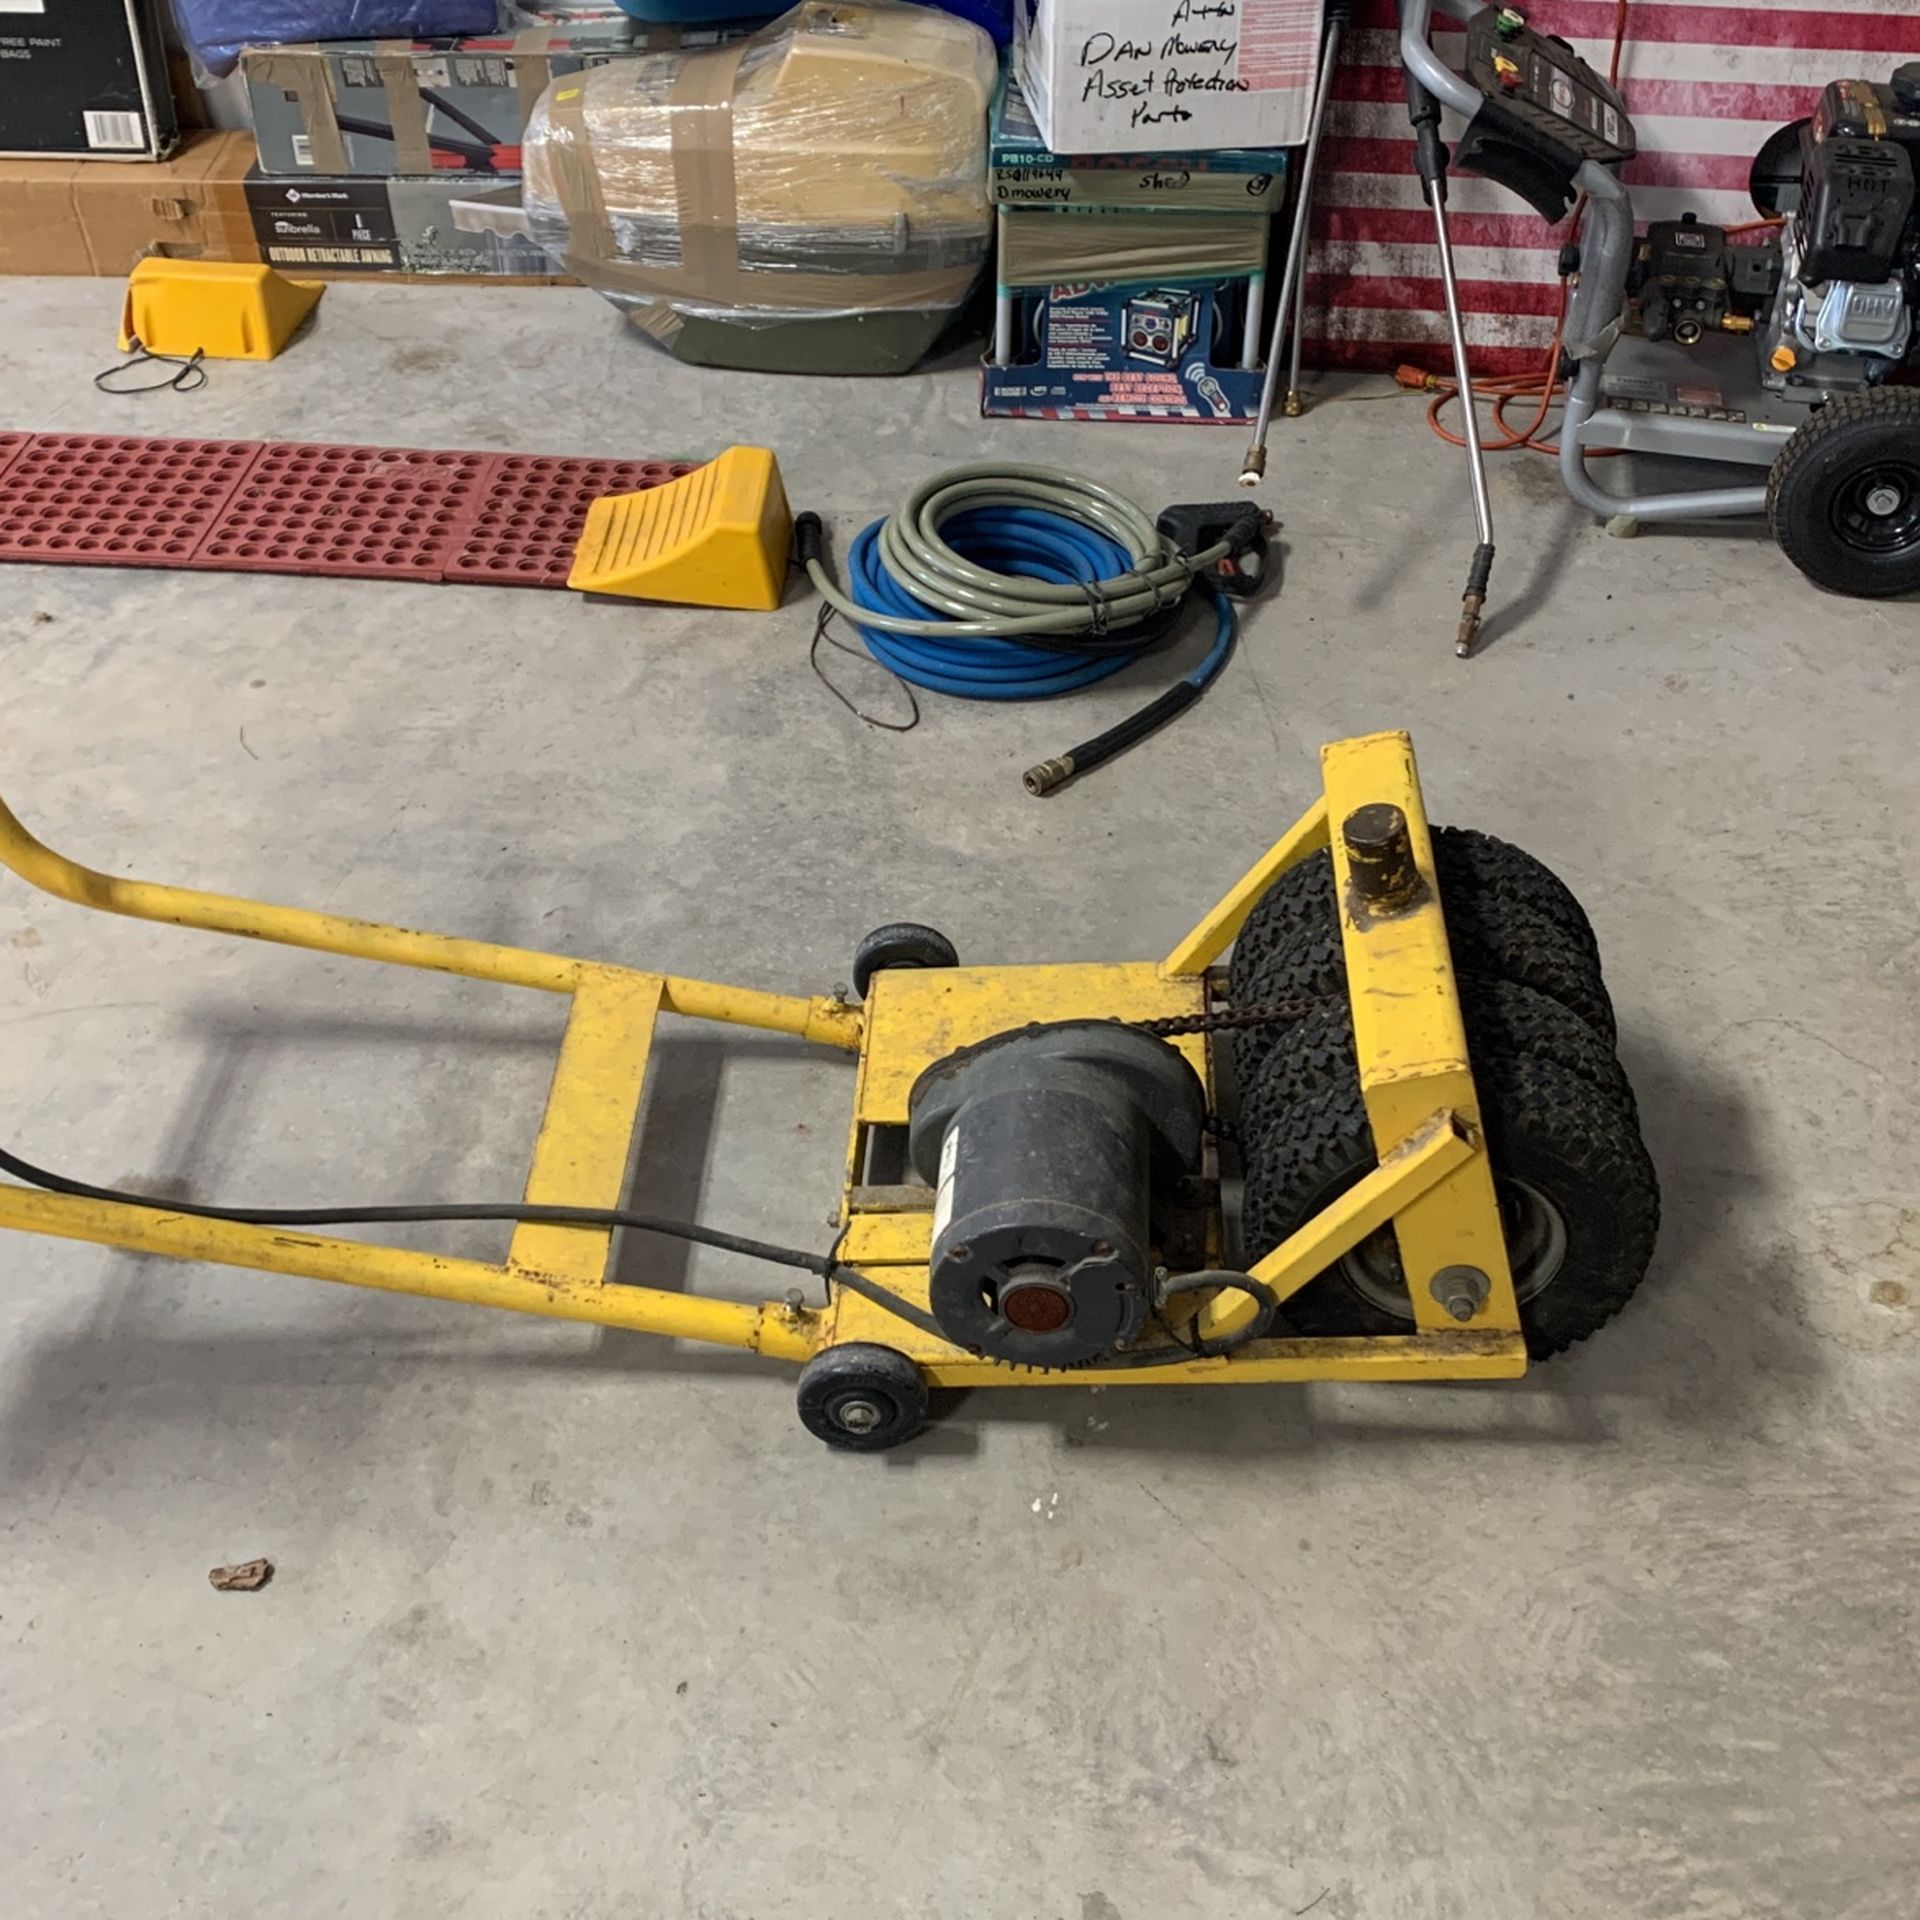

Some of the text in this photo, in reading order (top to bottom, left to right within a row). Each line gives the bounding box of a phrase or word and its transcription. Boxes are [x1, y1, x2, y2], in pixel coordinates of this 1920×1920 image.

[29, 38, 62, 47] PAINT
[1081, 32, 1152, 67] DAN
[1082, 69, 1153, 102] Asset
[1001, 153, 1055, 164] PB10-CD
